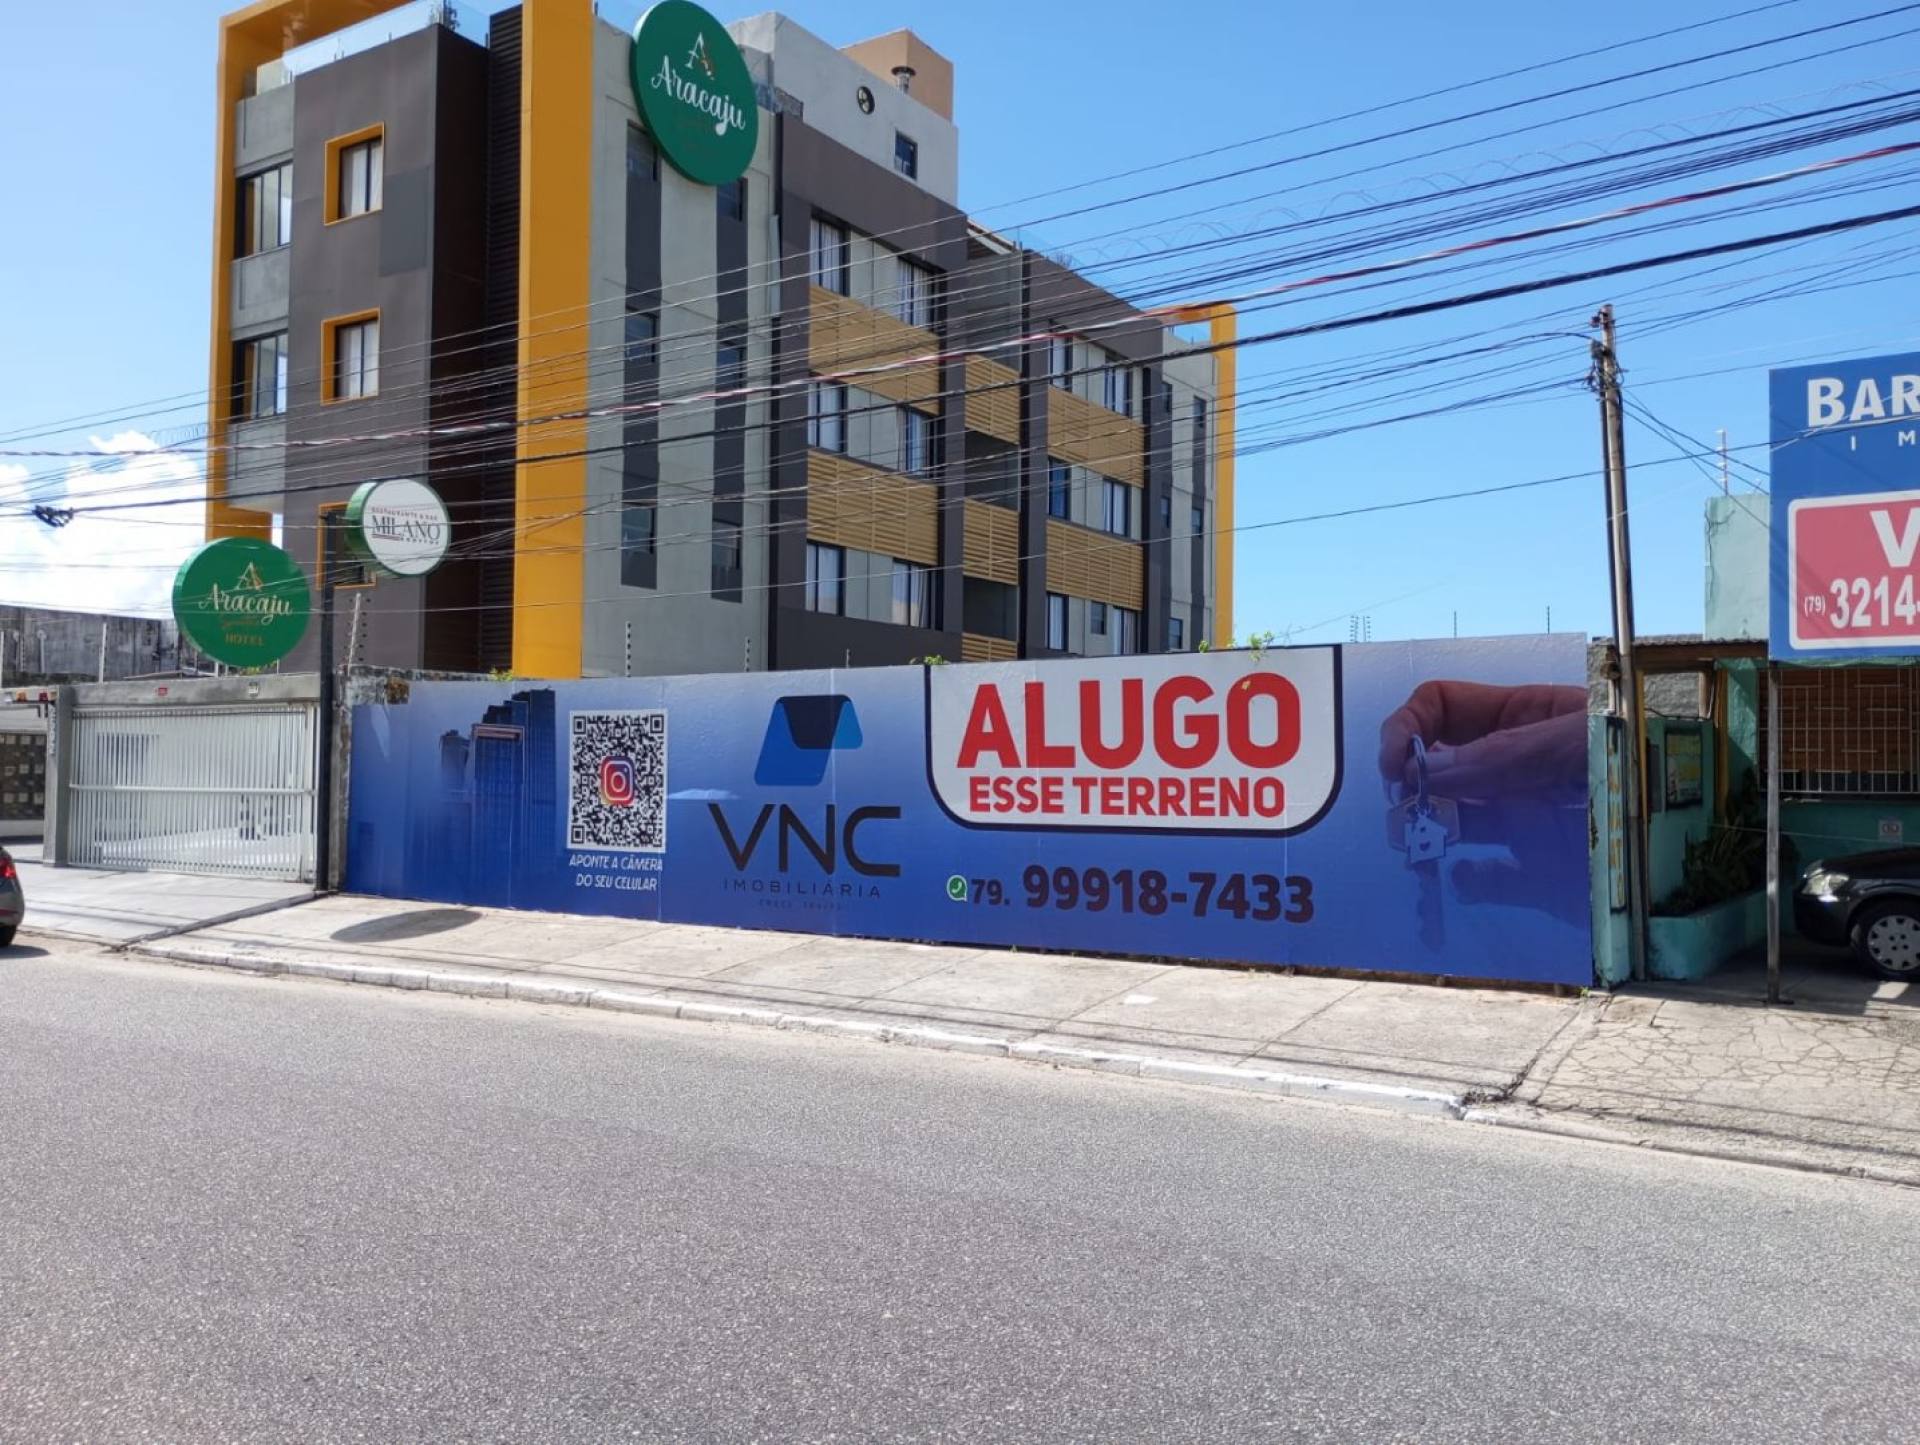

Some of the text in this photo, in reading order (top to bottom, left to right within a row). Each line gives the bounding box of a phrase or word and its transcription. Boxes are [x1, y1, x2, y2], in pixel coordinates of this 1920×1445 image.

[651, 55, 746, 136] Aracaju
[371, 514, 441, 540] MILANO
[198, 583, 293, 626] Aracaju
[1804, 596, 1826, 617] (79)
[956, 672, 1301, 769] ALUGO
[969, 776, 1286, 818] ESSE TERRENO
[708, 803, 901, 877] VNC
[569, 854, 663, 872] APONTE A CÂMERA
[576, 873, 658, 891] DO SEU CELULAR
[971, 865, 1315, 923] 79. 99918-7433
